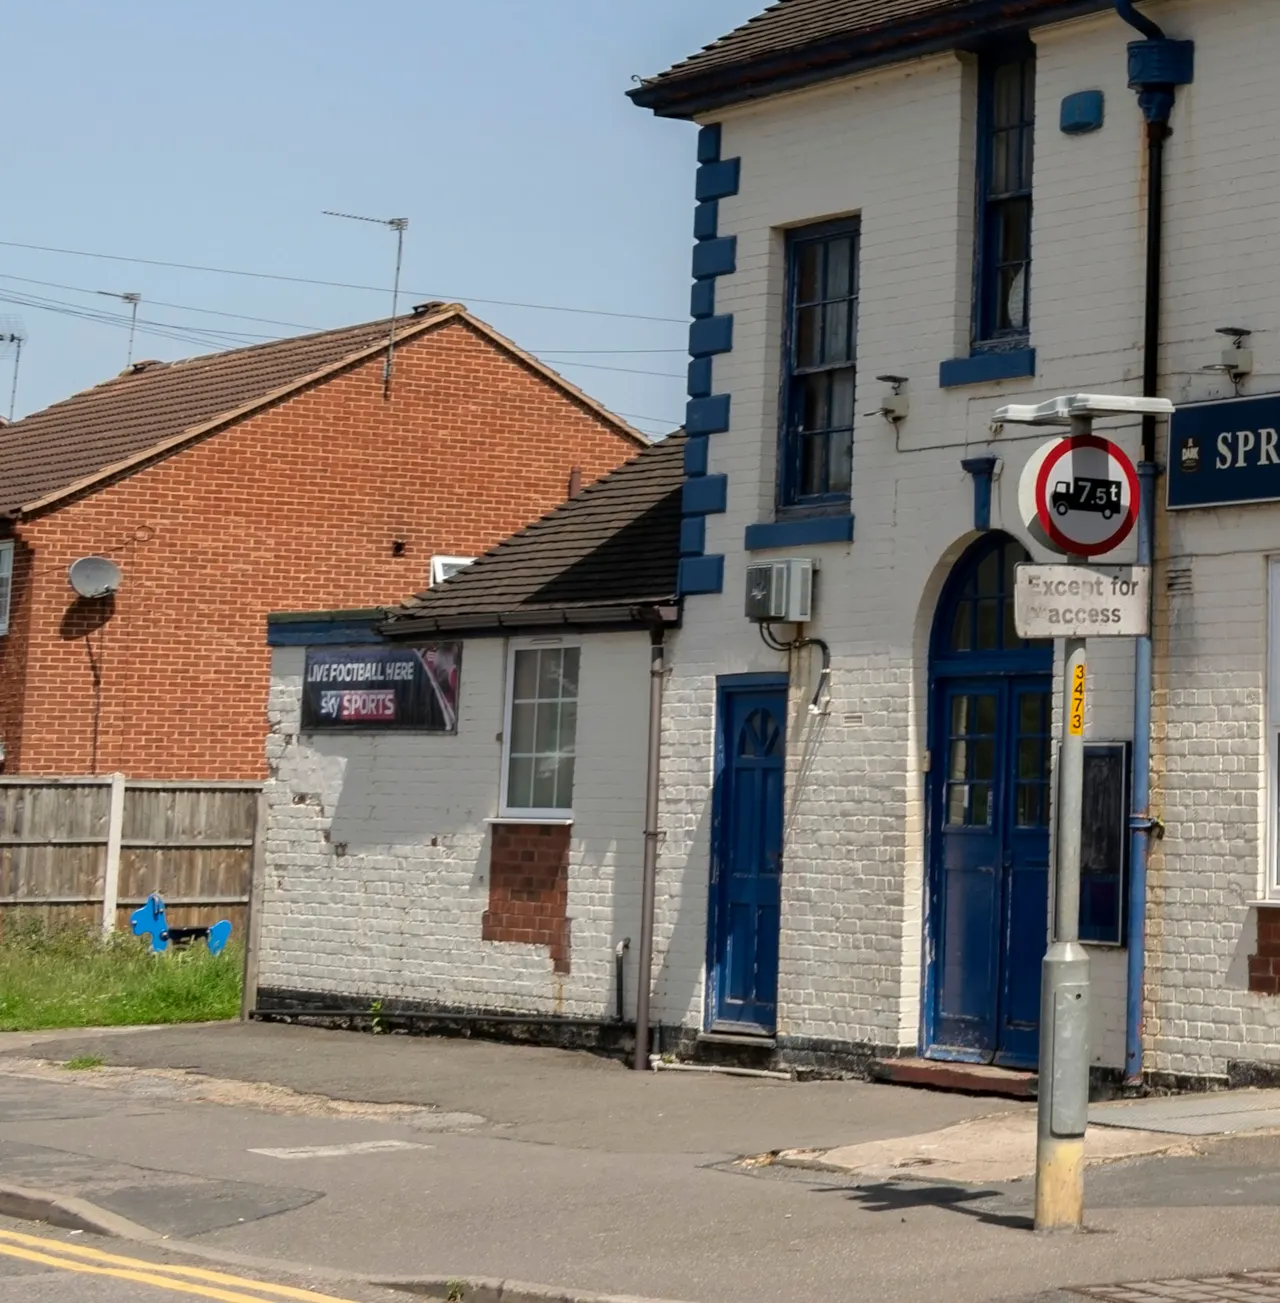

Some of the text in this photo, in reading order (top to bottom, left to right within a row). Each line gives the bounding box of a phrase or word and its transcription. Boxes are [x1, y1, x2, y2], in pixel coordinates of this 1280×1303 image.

[1110, 575, 1139, 597] for
[1048, 605, 1122, 624] access
[307, 661, 414, 682] LIVE FOOTBALL HERE
[320, 694, 395, 718] sky SPORTS
[1073, 664, 1085, 729] 3473
